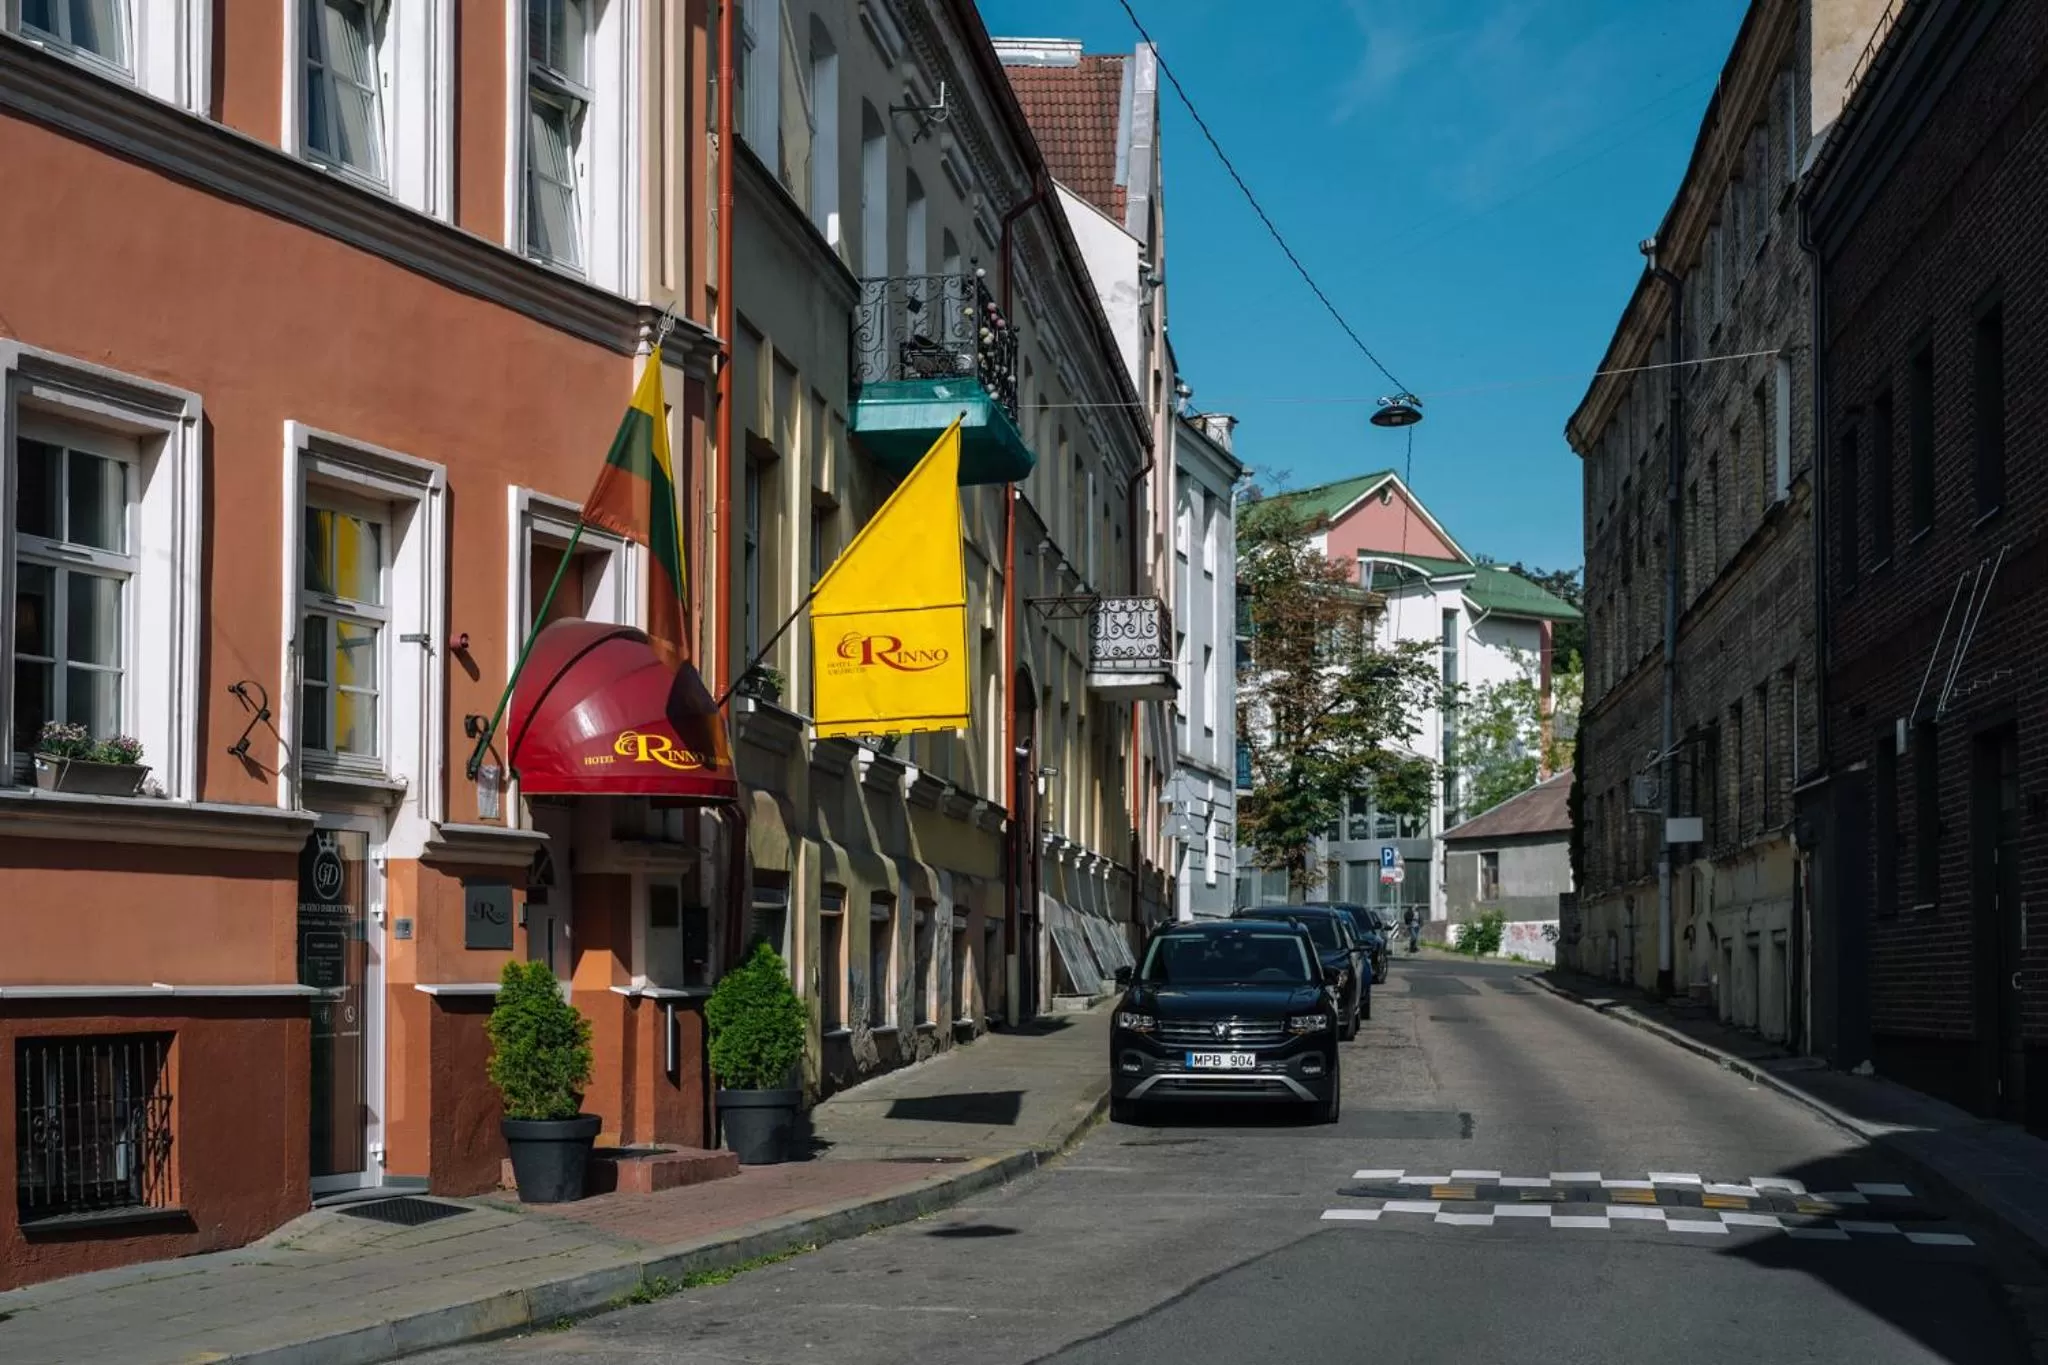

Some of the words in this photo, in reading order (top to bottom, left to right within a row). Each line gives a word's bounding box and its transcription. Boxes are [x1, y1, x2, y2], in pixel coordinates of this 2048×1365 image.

[584, 754, 615, 766] HOTEL
[1384, 848, 1392, 866] P
[1194, 1054, 1222, 1067] MPB
[1230, 1054, 1254, 1067] 904
